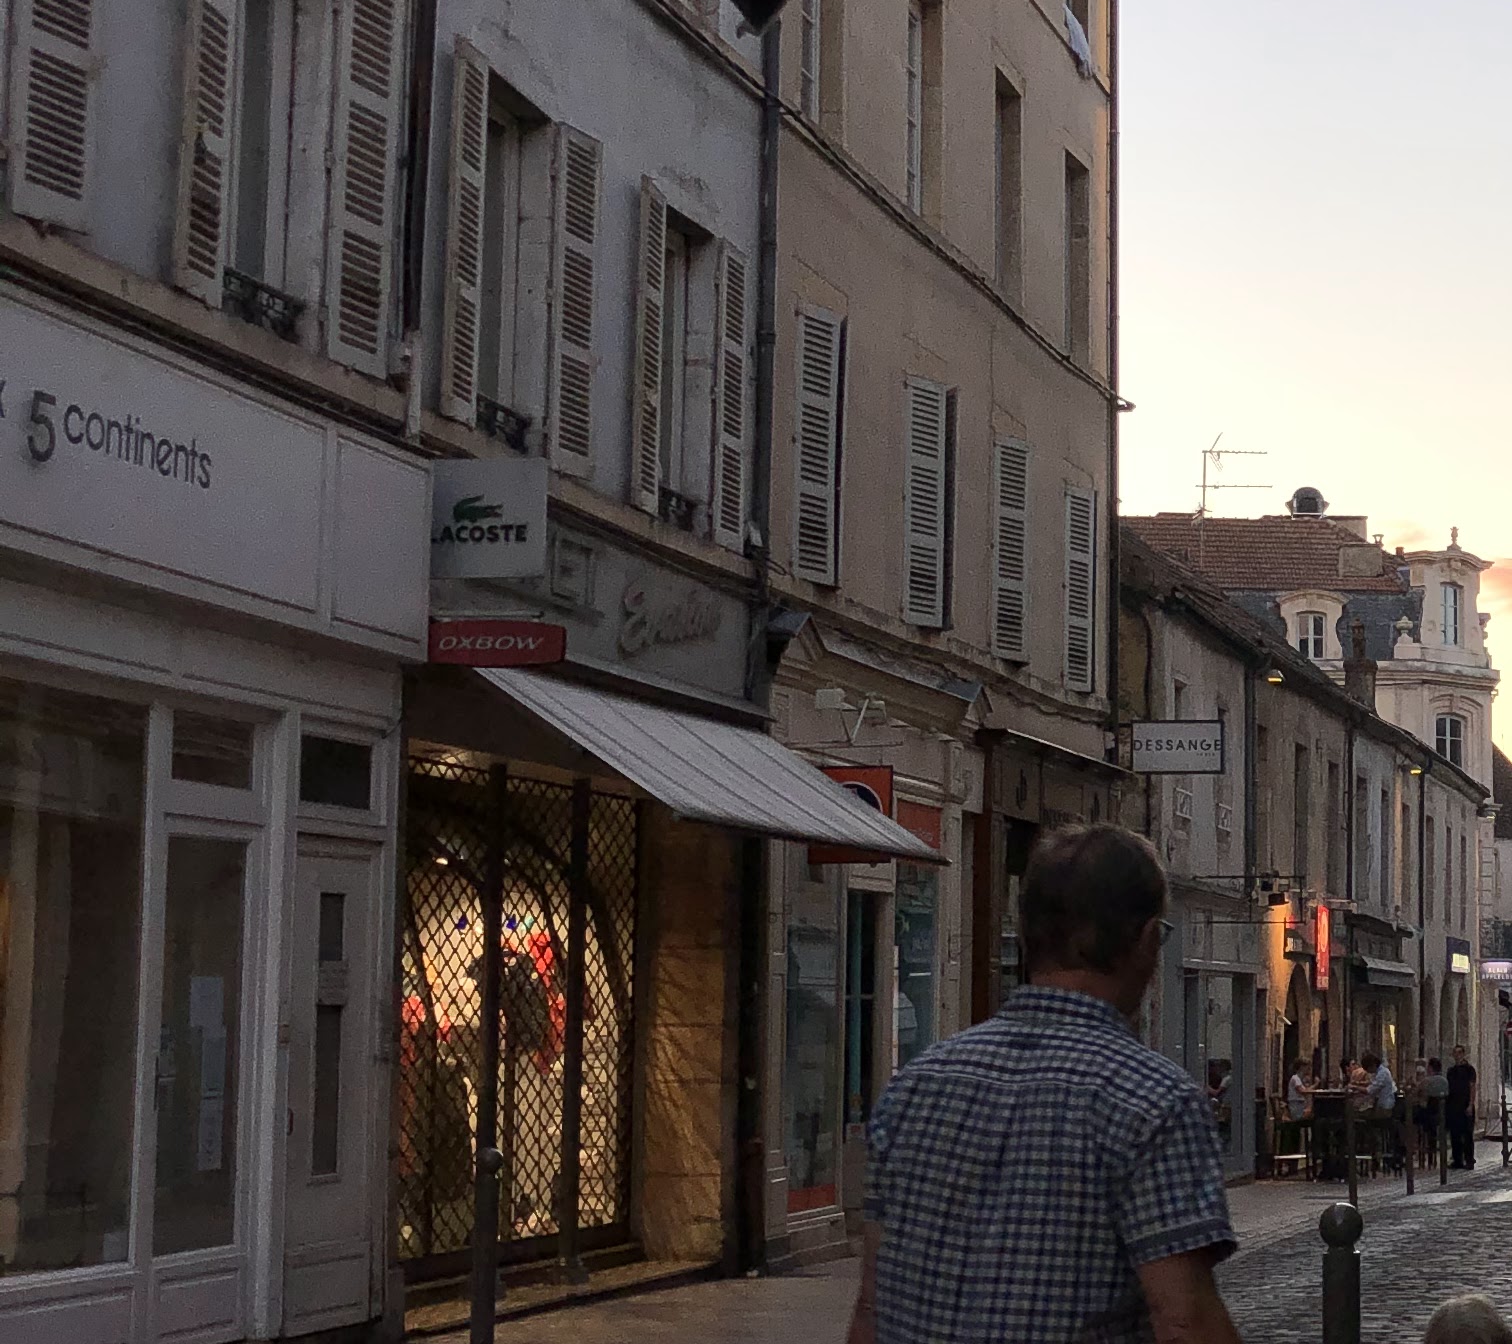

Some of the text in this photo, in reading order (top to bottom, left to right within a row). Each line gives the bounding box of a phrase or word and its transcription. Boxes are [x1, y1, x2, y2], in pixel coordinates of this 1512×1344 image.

[27, 390, 56, 463] 5
[64, 404, 212, 488] continents
[438, 634, 544, 651] OXBOW
[1133, 739, 1222, 751] DESSANGE
